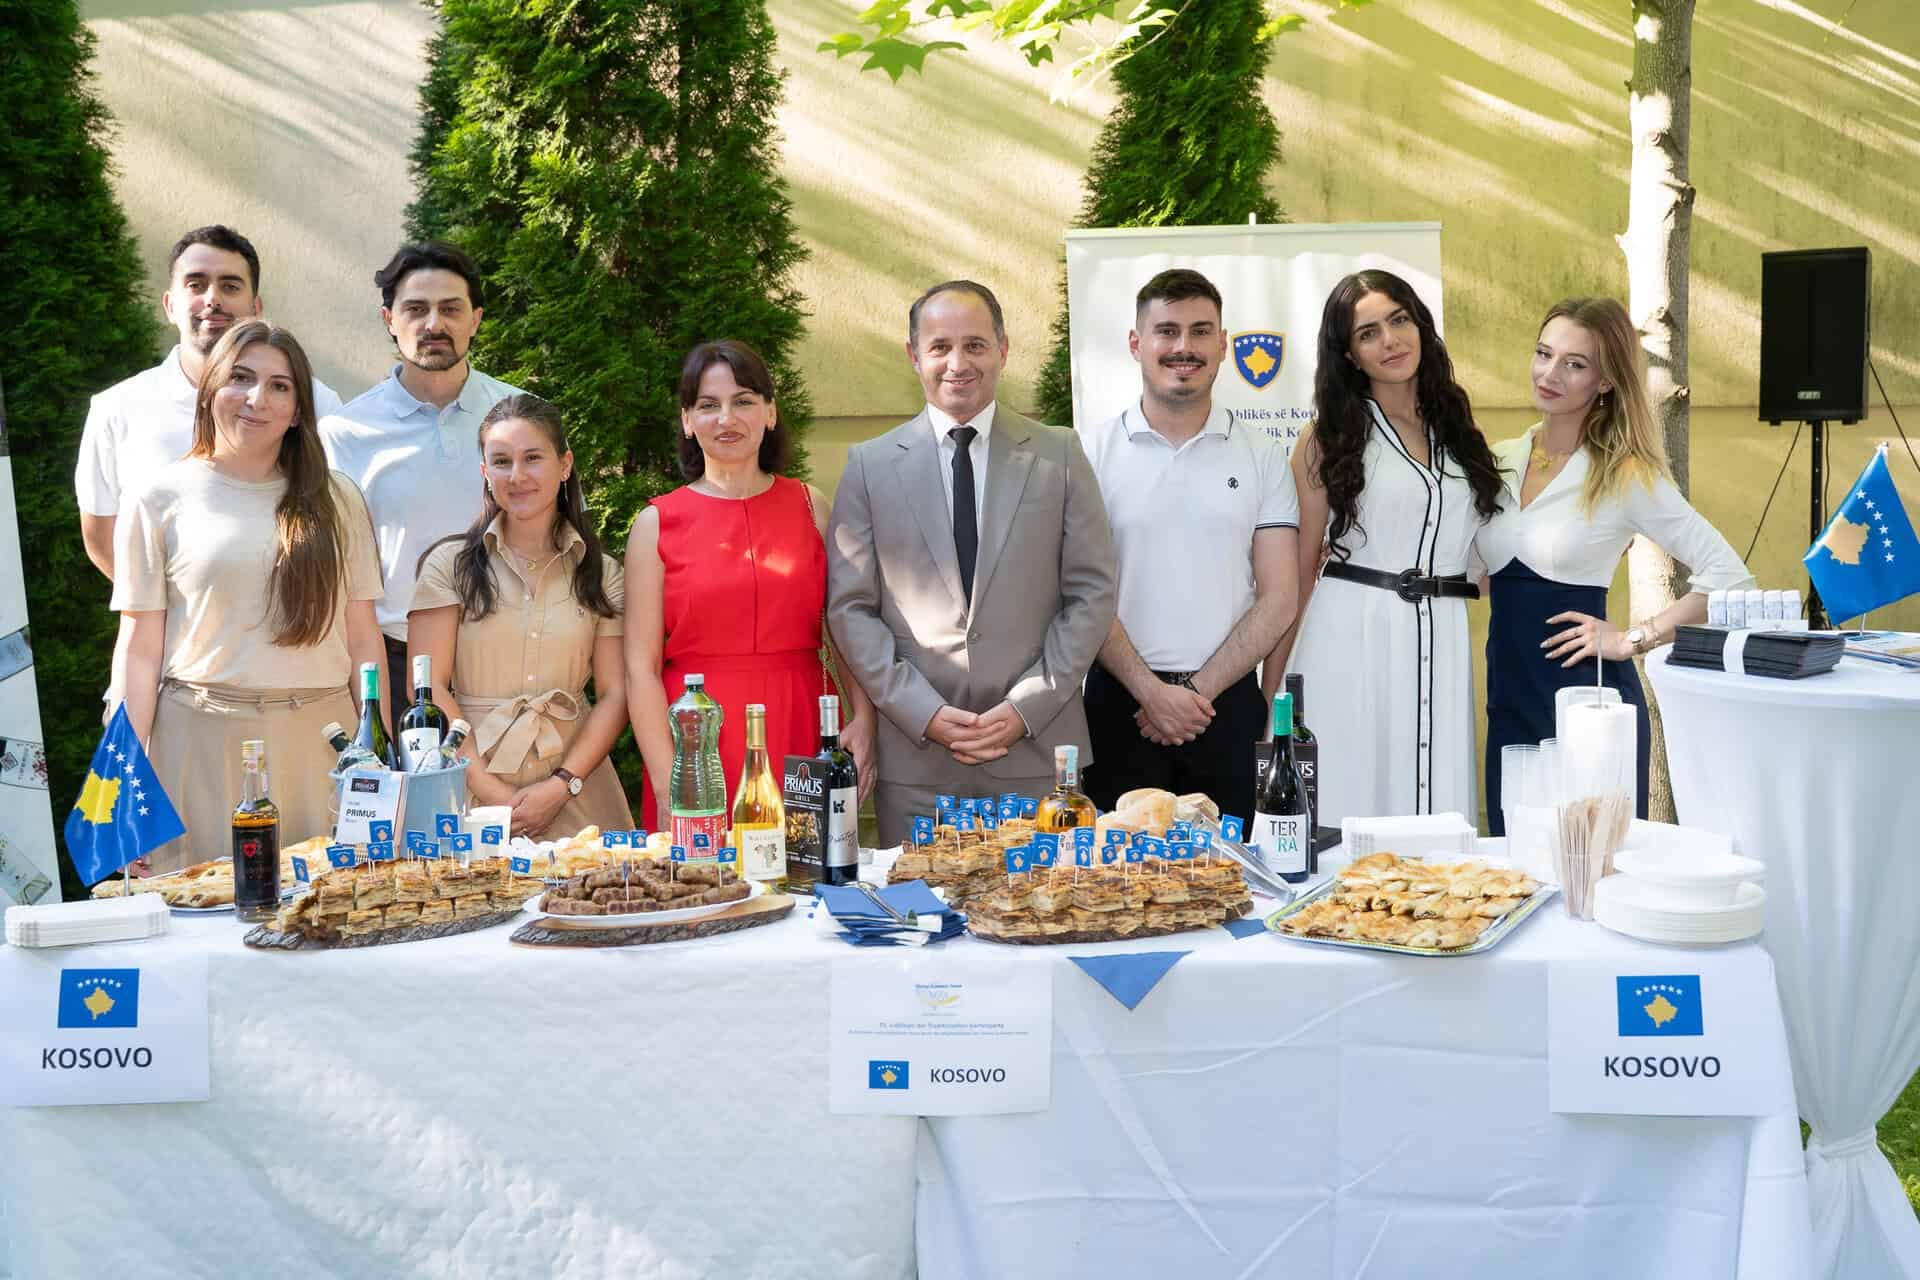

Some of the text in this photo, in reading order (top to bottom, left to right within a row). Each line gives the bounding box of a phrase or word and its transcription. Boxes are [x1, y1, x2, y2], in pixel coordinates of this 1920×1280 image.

[784, 775, 823, 794] PRIMUS
[345, 808, 377, 818] PRIMUS
[1270, 820, 1298, 836] TER
[1277, 837, 1298, 852] RA
[41, 1047, 153, 1070] KOSOVO
[1603, 1056, 1721, 1078] KOSOVO
[930, 1068, 1006, 1083] KOSOVO
